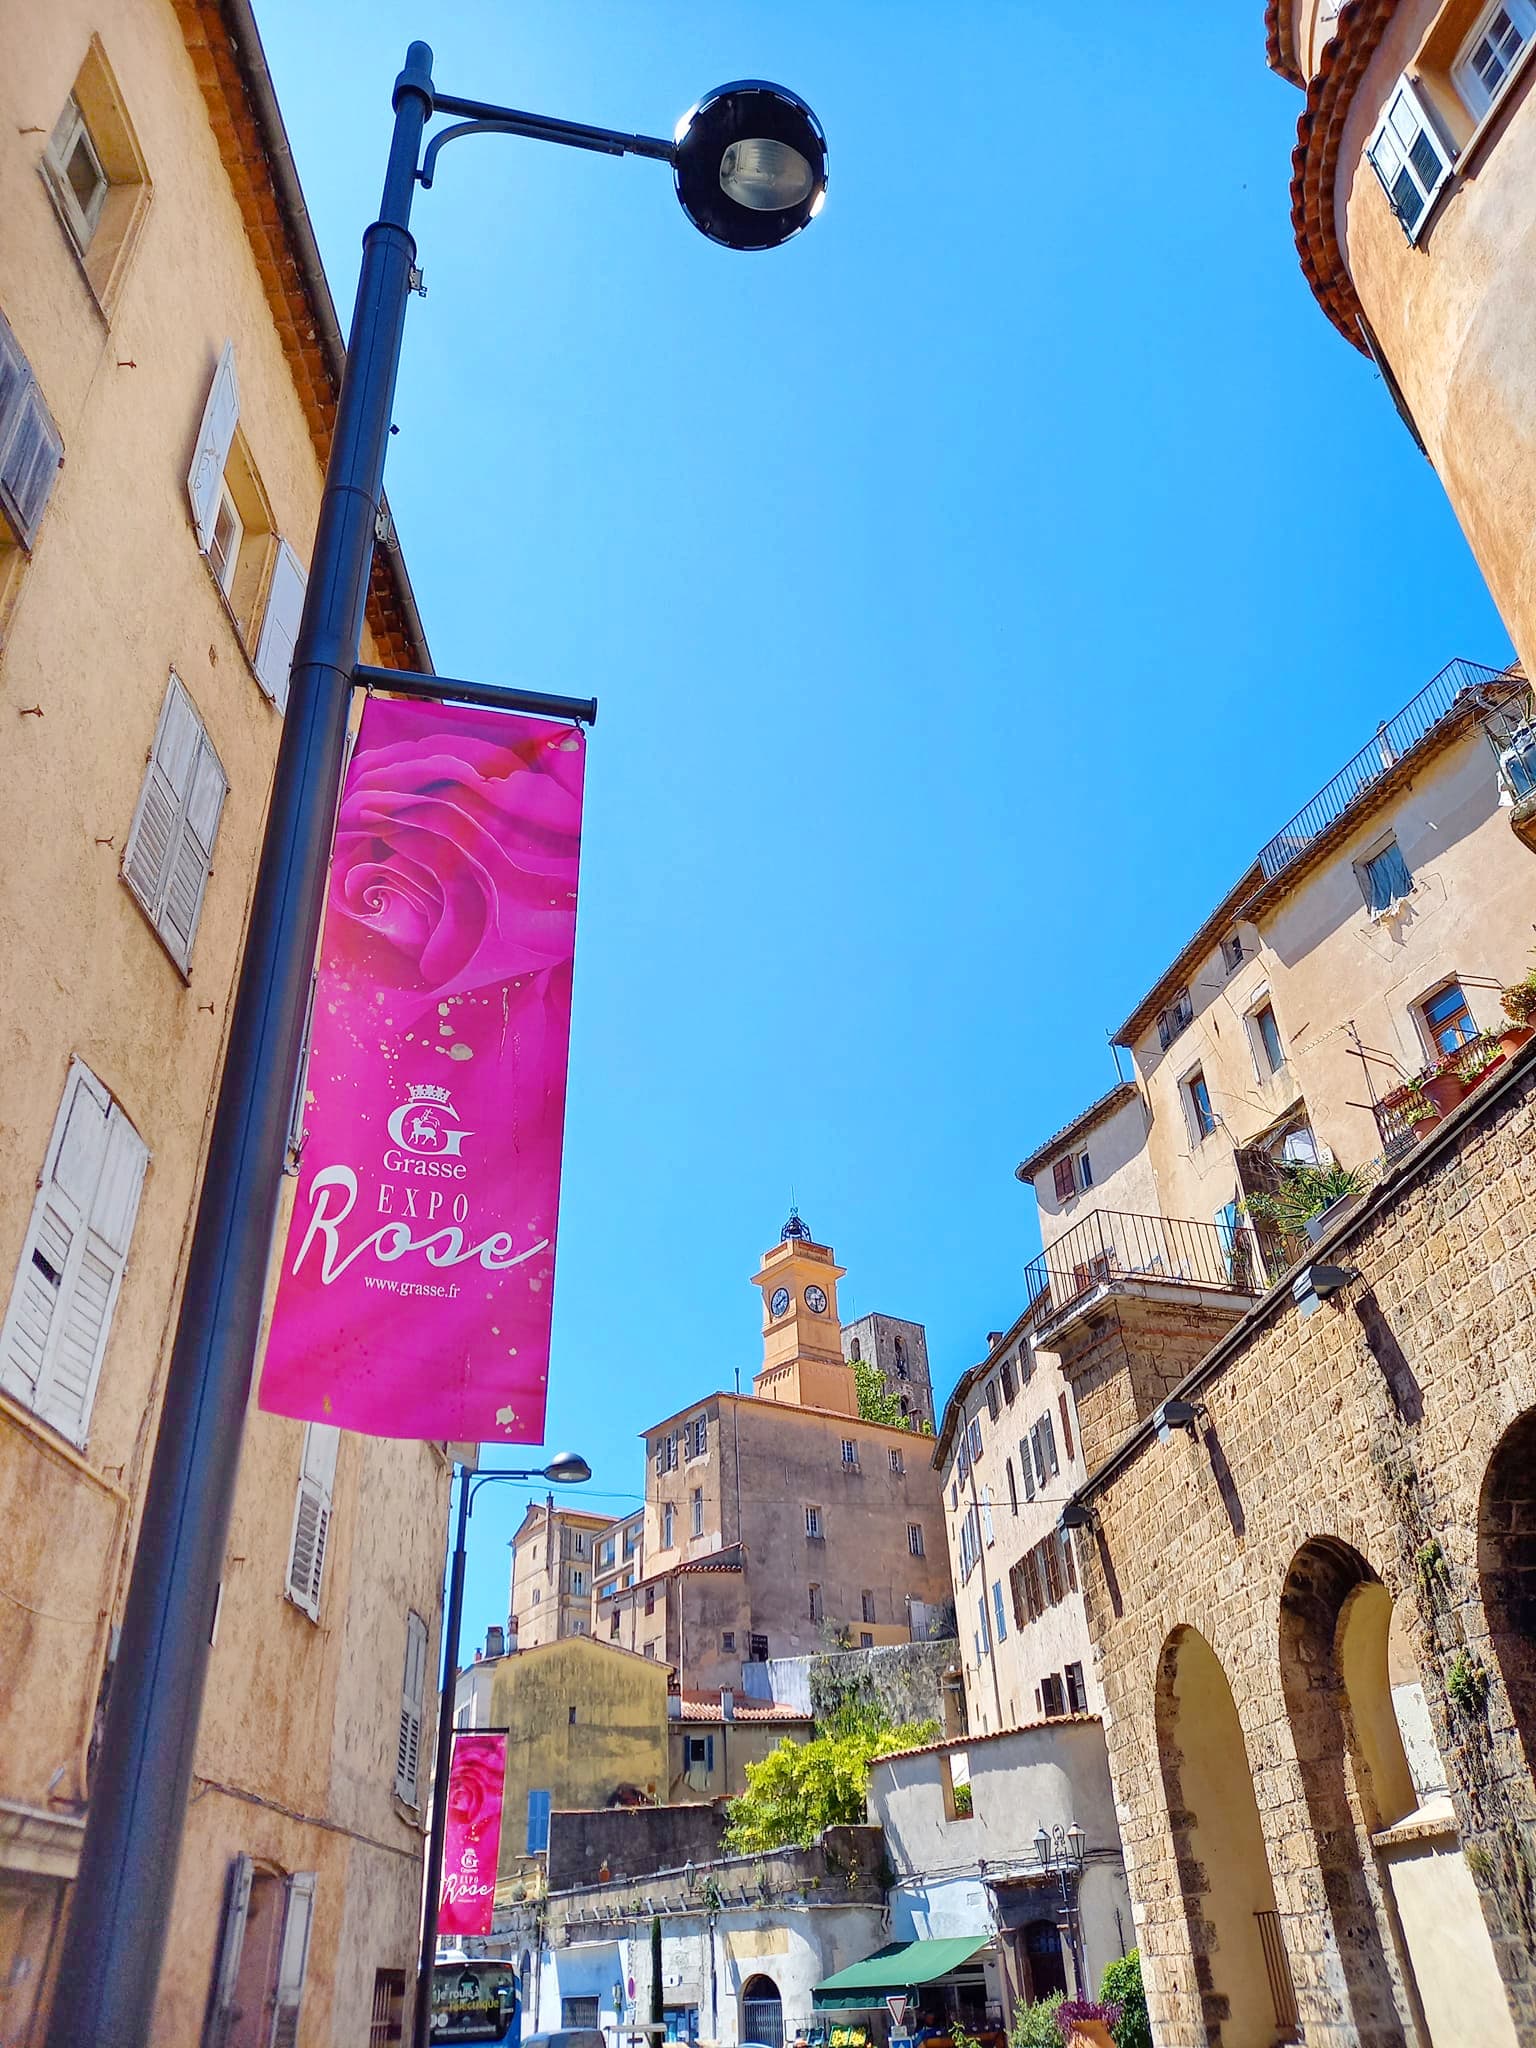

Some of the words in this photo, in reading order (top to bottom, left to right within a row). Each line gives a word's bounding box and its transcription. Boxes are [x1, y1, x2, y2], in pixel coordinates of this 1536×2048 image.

[383, 1150, 467, 1179] Grasse
[377, 1184, 469, 1222] EXPO
[292, 1164, 549, 1285] Rose
[364, 1276, 461, 1298] www.grasse.fr
[442, 1873, 495, 1904] Rose
